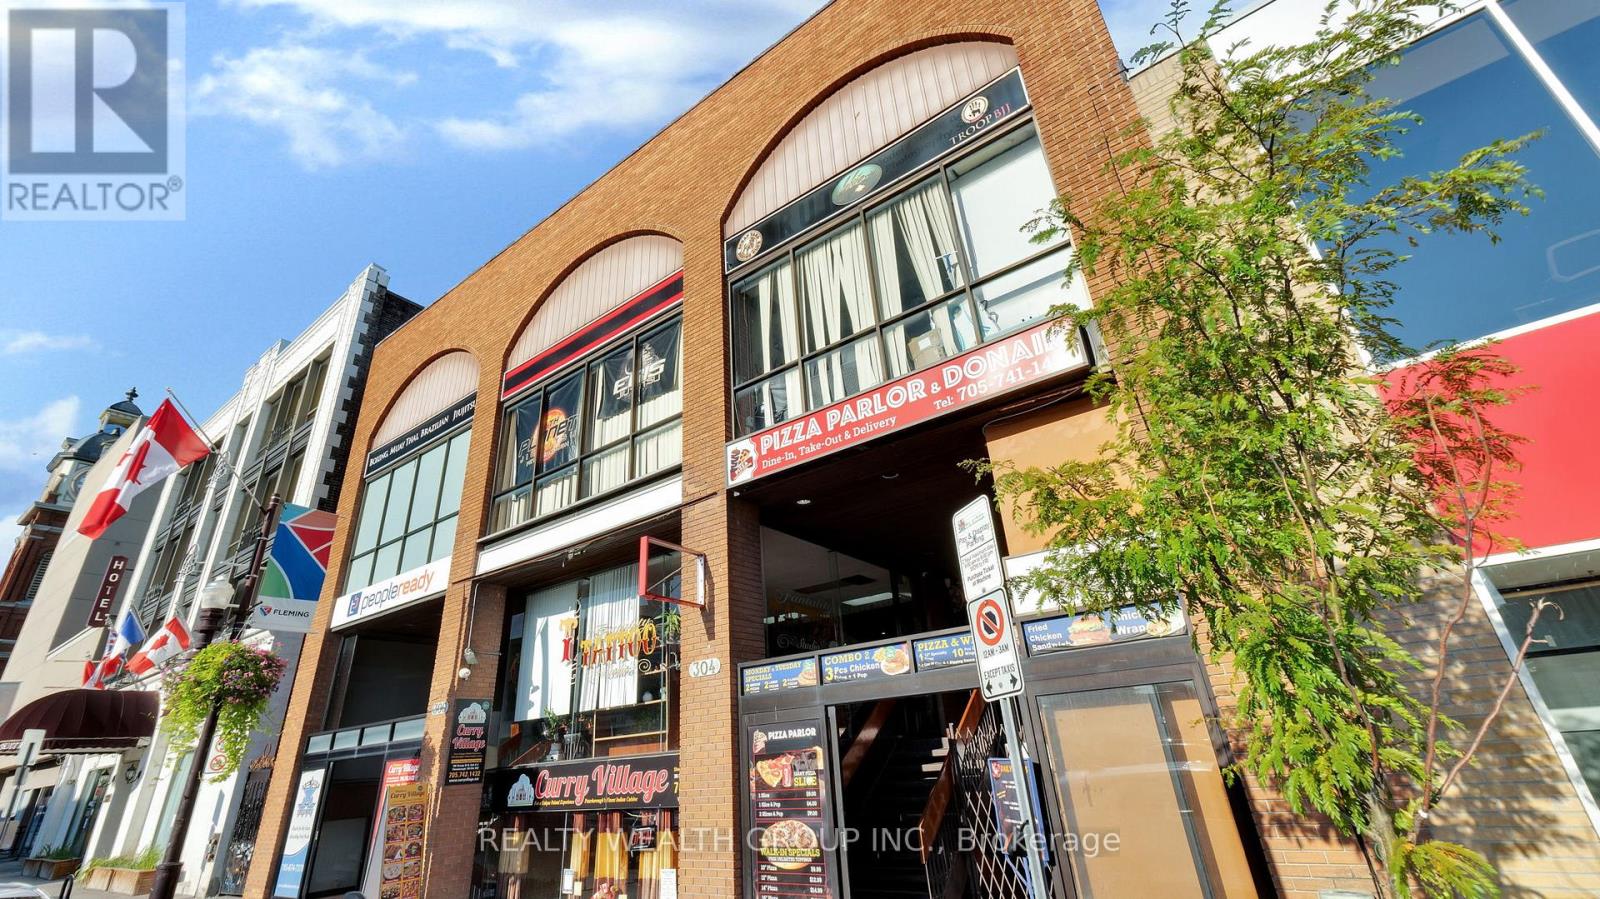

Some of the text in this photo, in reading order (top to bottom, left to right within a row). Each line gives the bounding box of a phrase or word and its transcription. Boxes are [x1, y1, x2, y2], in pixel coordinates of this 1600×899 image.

[948, 103, 1011, 146] TROOP BJJ
[760, 417, 823, 455] PIZZA
[826, 379, 926, 431] PARLOR
[931, 382, 940, 393] &
[369, 451, 389, 467] BOXING
[390, 442, 405, 455] MUAY
[405, 433, 419, 447] THAI
[420, 415, 450, 438] BRAZILIAN
[762, 416, 897, 469] Dine-In, Take-Out & Delivery
[95, 560, 124, 622] HOTEL
[360, 568, 435, 616] peopleready
[273, 609, 310, 618] FLEMING
[1027, 623, 1048, 633] Fried
[918, 639, 949, 652] PIZZA
[951, 637, 959, 647] &
[1029, 632, 1062, 642] Chicken
[824, 652, 862, 666] COMBO
[952, 647, 964, 658] 10
[692, 659, 716, 676] 304
[825, 667, 833, 681] 3
[834, 662, 880, 675] Pcs Chicken
[984, 663, 1016, 680] EXCEPT TAXIS
[457, 724, 484, 738] Curry
[768, 728, 817, 740] PIZZA PARLOR
[452, 737, 486, 752] Village
[535, 769, 590, 806] Curry
[592, 764, 670, 803] Village
[760, 847, 821, 857] WALK-IN SPECIALS
